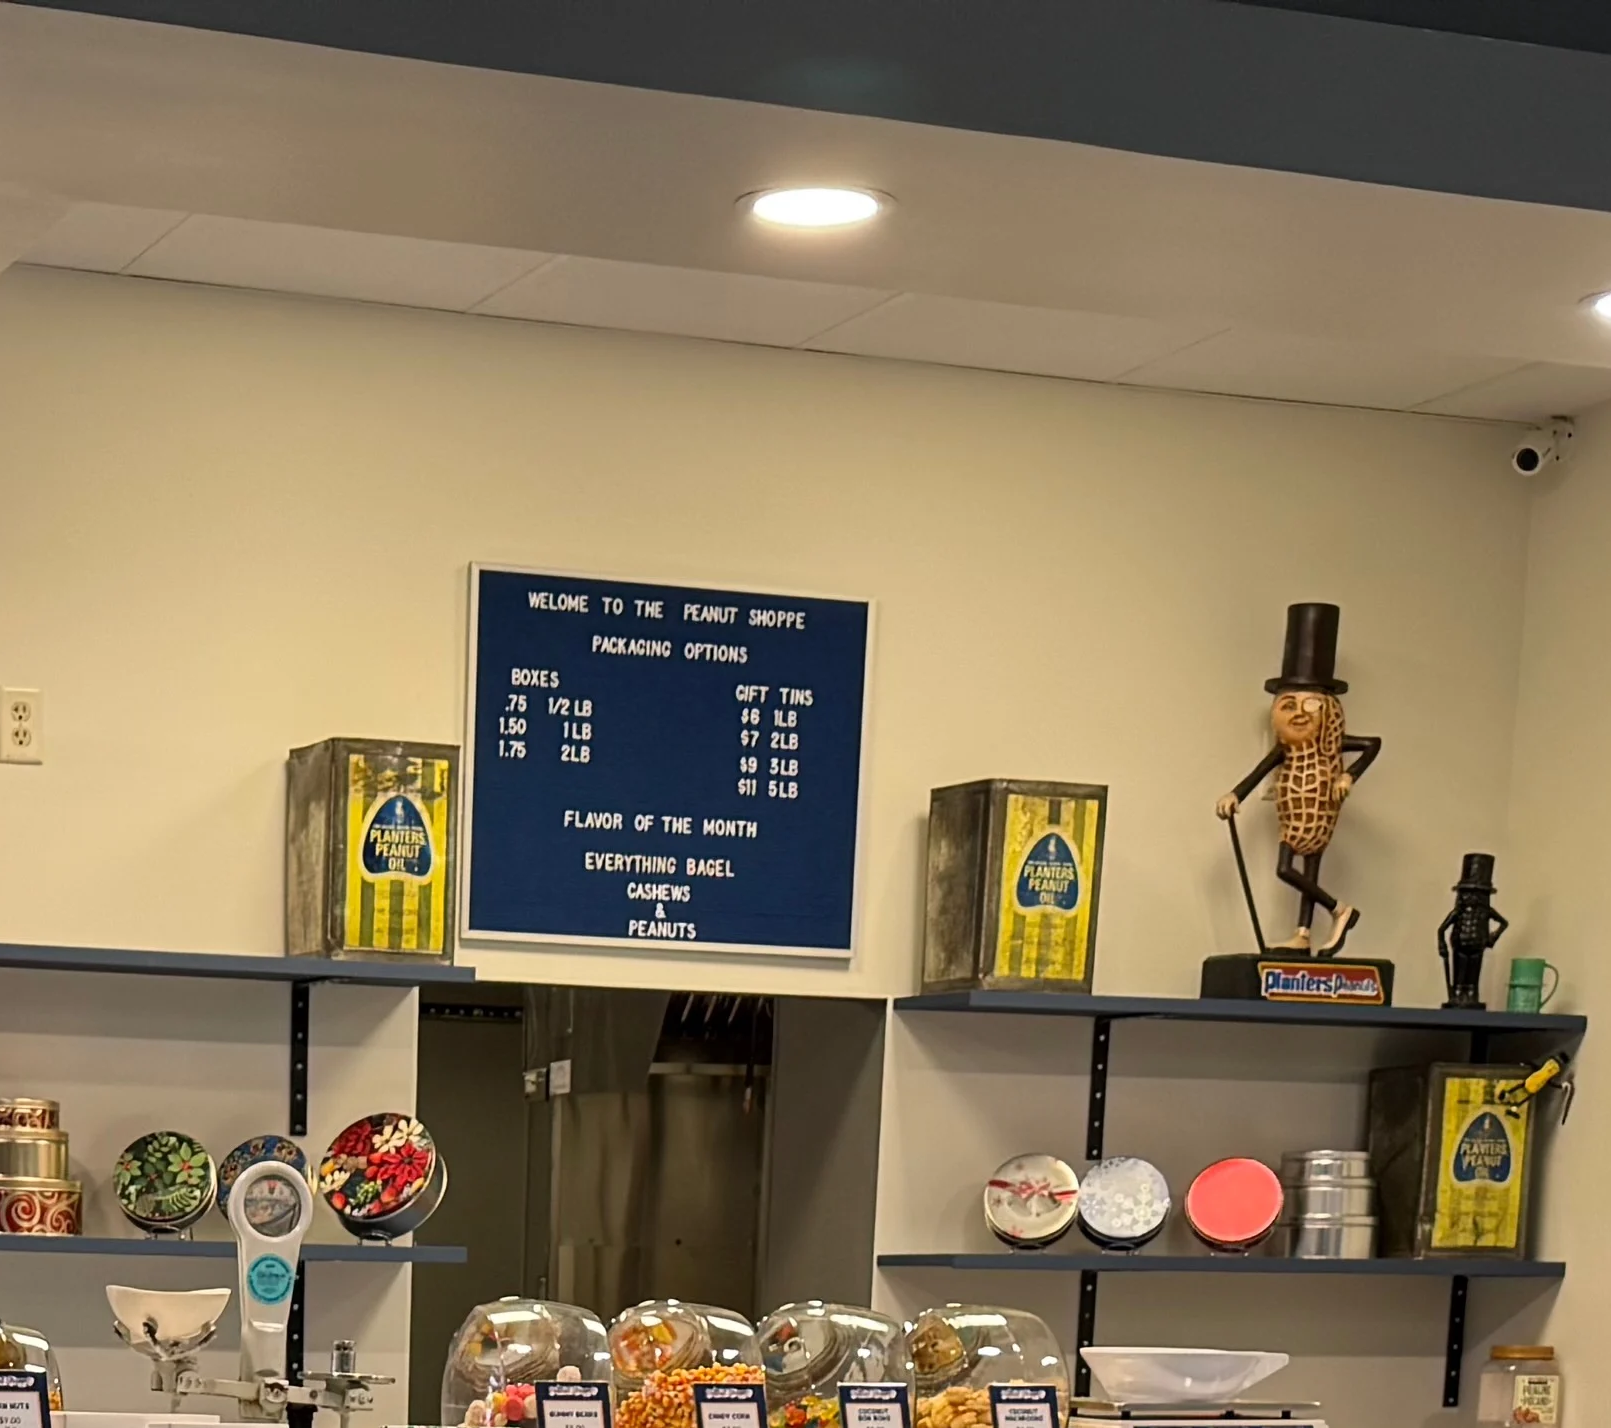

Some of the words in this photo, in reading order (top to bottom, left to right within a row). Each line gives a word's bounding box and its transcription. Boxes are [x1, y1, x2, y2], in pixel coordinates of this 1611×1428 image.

[528, 592, 589, 613] WELOME
[602, 597, 623, 615] TO
[634, 600, 664, 618] THE
[683, 603, 738, 624] PEANUT
[748, 609, 806, 630] SHOPPE
[592, 635, 671, 657] PACKAGING
[684, 642, 748, 663] OPTIONS
[511, 668, 559, 688] BOXES
[735, 684, 769, 703] GIFT
[779, 687, 813, 706] TINS
[548, 697, 570, 716] 1/2
[574, 700, 592, 717] LB
[499, 717, 527, 735] 1.50
[499, 739, 526, 758] 1.75
[740, 729, 759, 748] $7
[770, 731, 798, 750] 2LB
[740, 756, 757, 773] $9
[769, 758, 798, 776] 3LB
[738, 778, 757, 796] $11
[564, 810, 623, 830] FLAVOR
[634, 814, 654, 832] OF
[661, 816, 692, 834] THE
[703, 819, 757, 838] MONTH
[370, 830, 426, 845] PLANTERS
[376, 844, 421, 858] PEANUT
[388, 859, 405, 871] OIL
[585, 852, 677, 874] EVERYTHING
[686, 858, 735, 877] BAGEL
[1024, 865, 1075, 880] PLANTERS
[627, 882, 690, 902] CASHEWS
[1028, 880, 1069, 893] PEANUT
[1039, 893, 1055, 904] OIL
[655, 902, 666, 919] &
[628, 920, 696, 939] PEANUTS
[1264, 969, 1334, 993] Planters
[9, 1402, 29, 1410] NUTS
